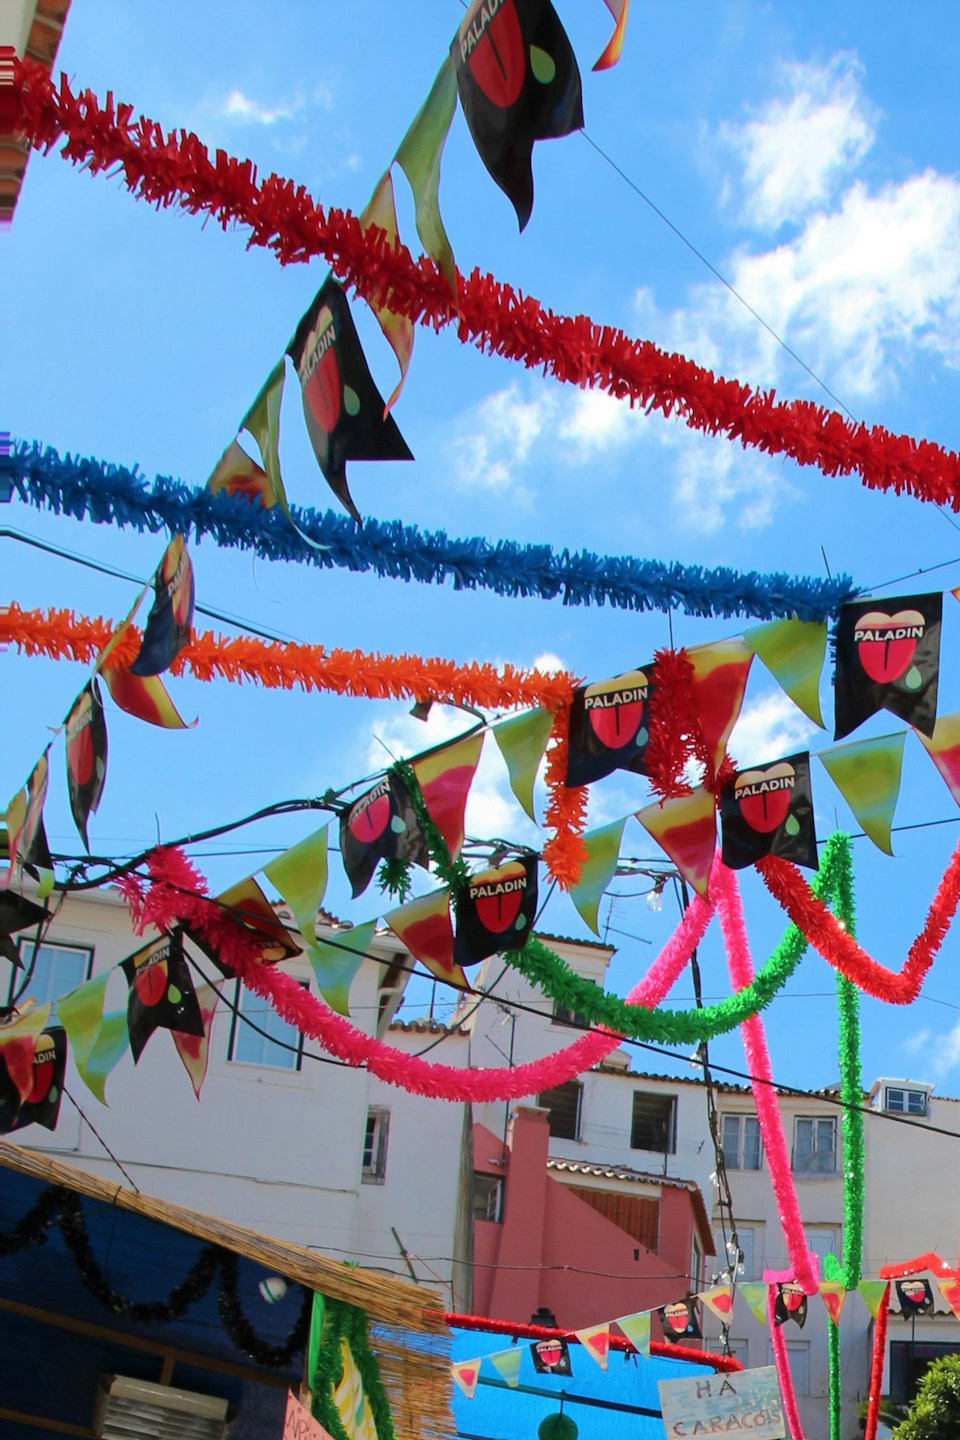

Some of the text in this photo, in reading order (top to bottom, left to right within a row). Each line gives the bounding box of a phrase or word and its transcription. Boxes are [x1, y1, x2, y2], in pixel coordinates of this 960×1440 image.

[460, 0, 504, 64] PALAD
[854, 625, 924, 642] PALADIN
[584, 686, 649, 710] PALADIN
[734, 775, 796, 800] PALADIN
[469, 877, 528, 900] PALADIN
[33, 1050, 57, 1065] ADIN
